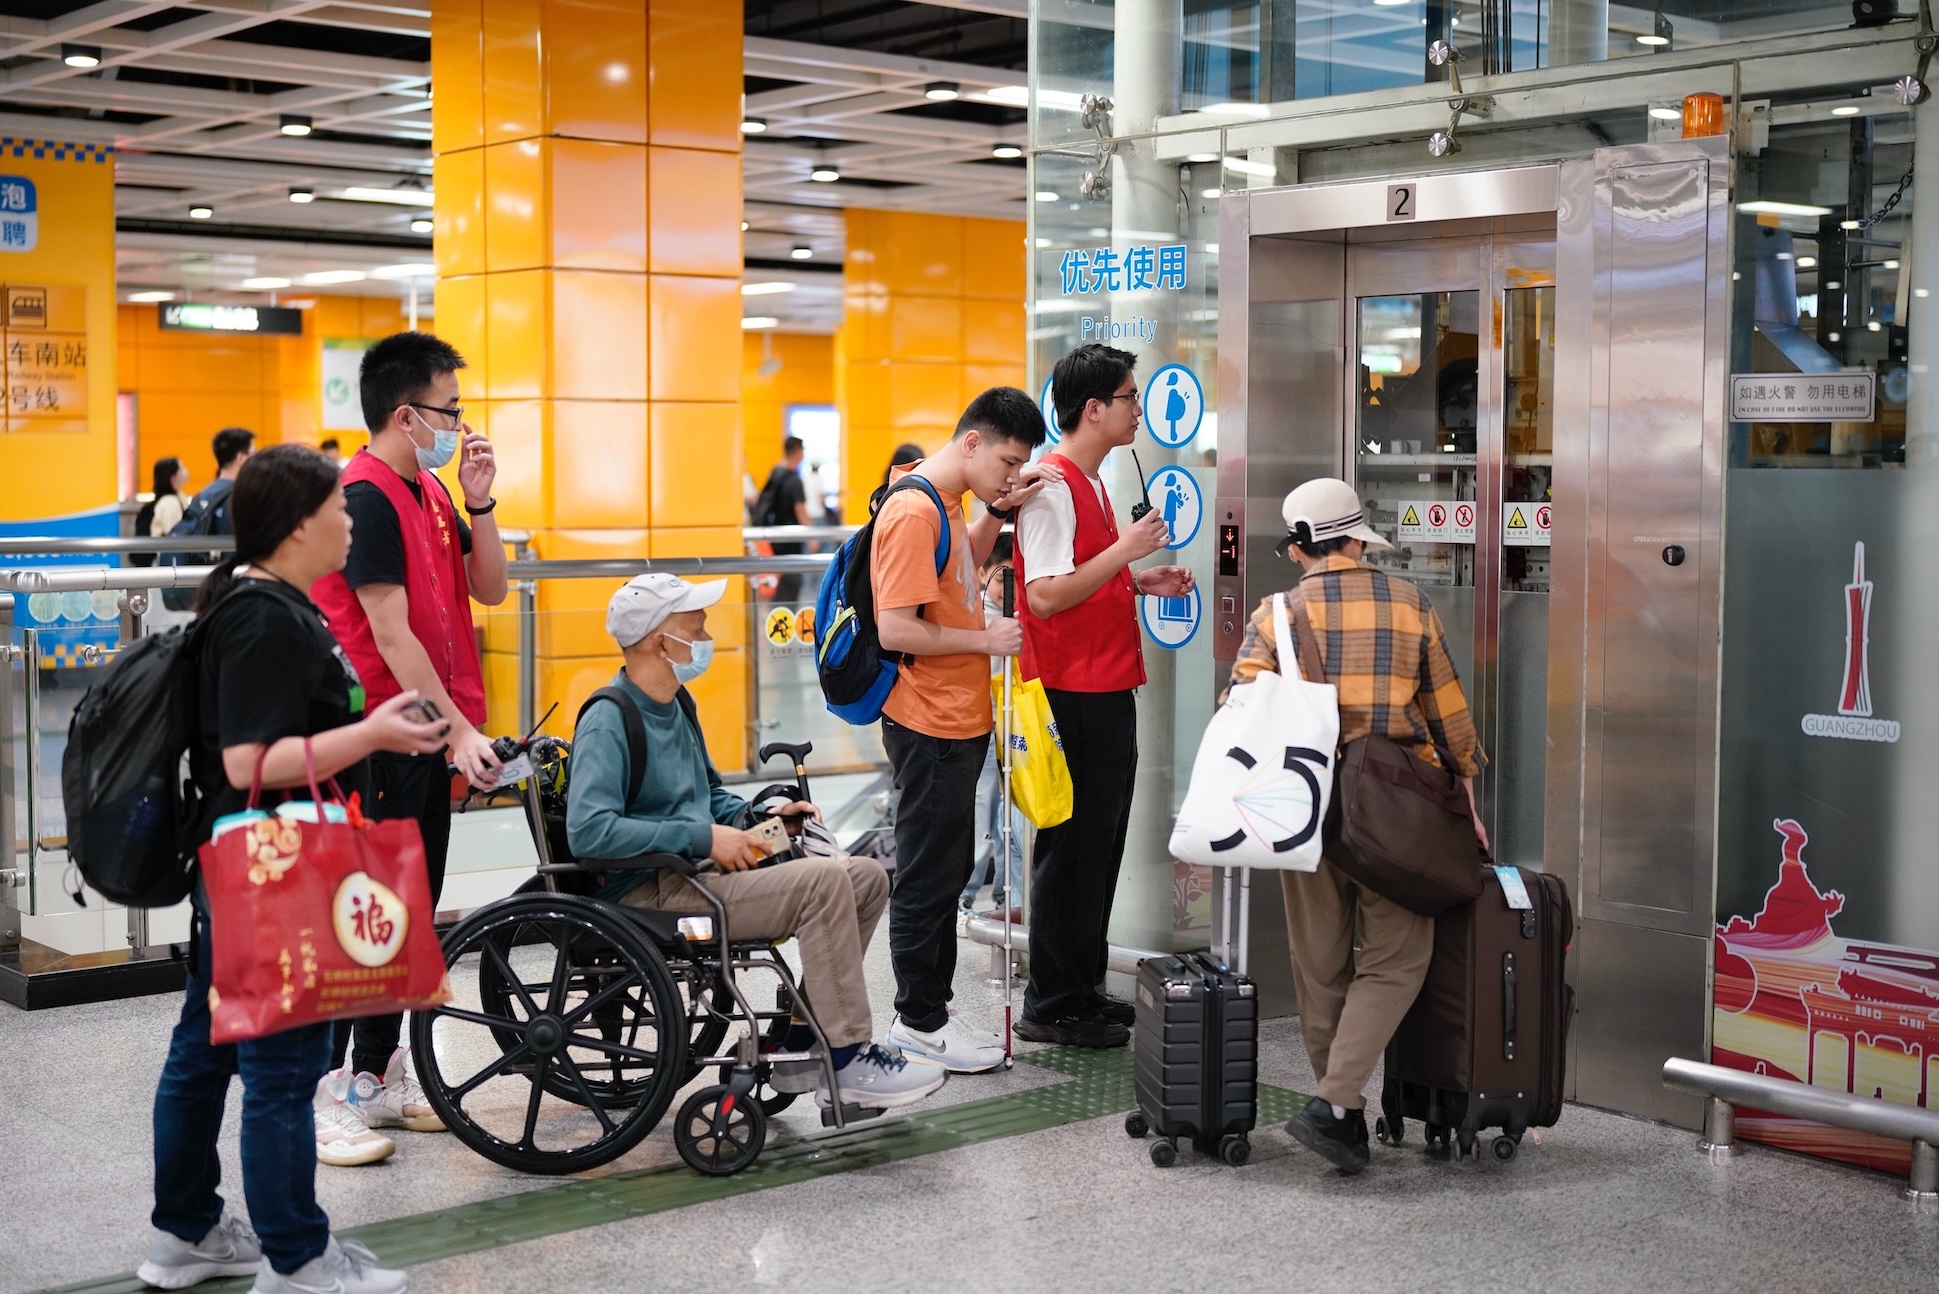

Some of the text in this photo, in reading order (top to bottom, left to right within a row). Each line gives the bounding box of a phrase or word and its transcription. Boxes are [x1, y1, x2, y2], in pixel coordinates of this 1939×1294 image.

[1, 183, 27, 210] 泡
[1395, 188, 1410, 216] 2
[3, 221, 26, 246] 聘
[1059, 245, 1187, 295] 优先使用
[1081, 315, 1157, 342] Priority
[0, 341, 86, 367] 车南站
[1739, 384, 1867, 400] 如遇火警 勿用电梯
[1805, 718, 1897, 739] GUANGZHOU
[351, 893, 394, 946] 福
